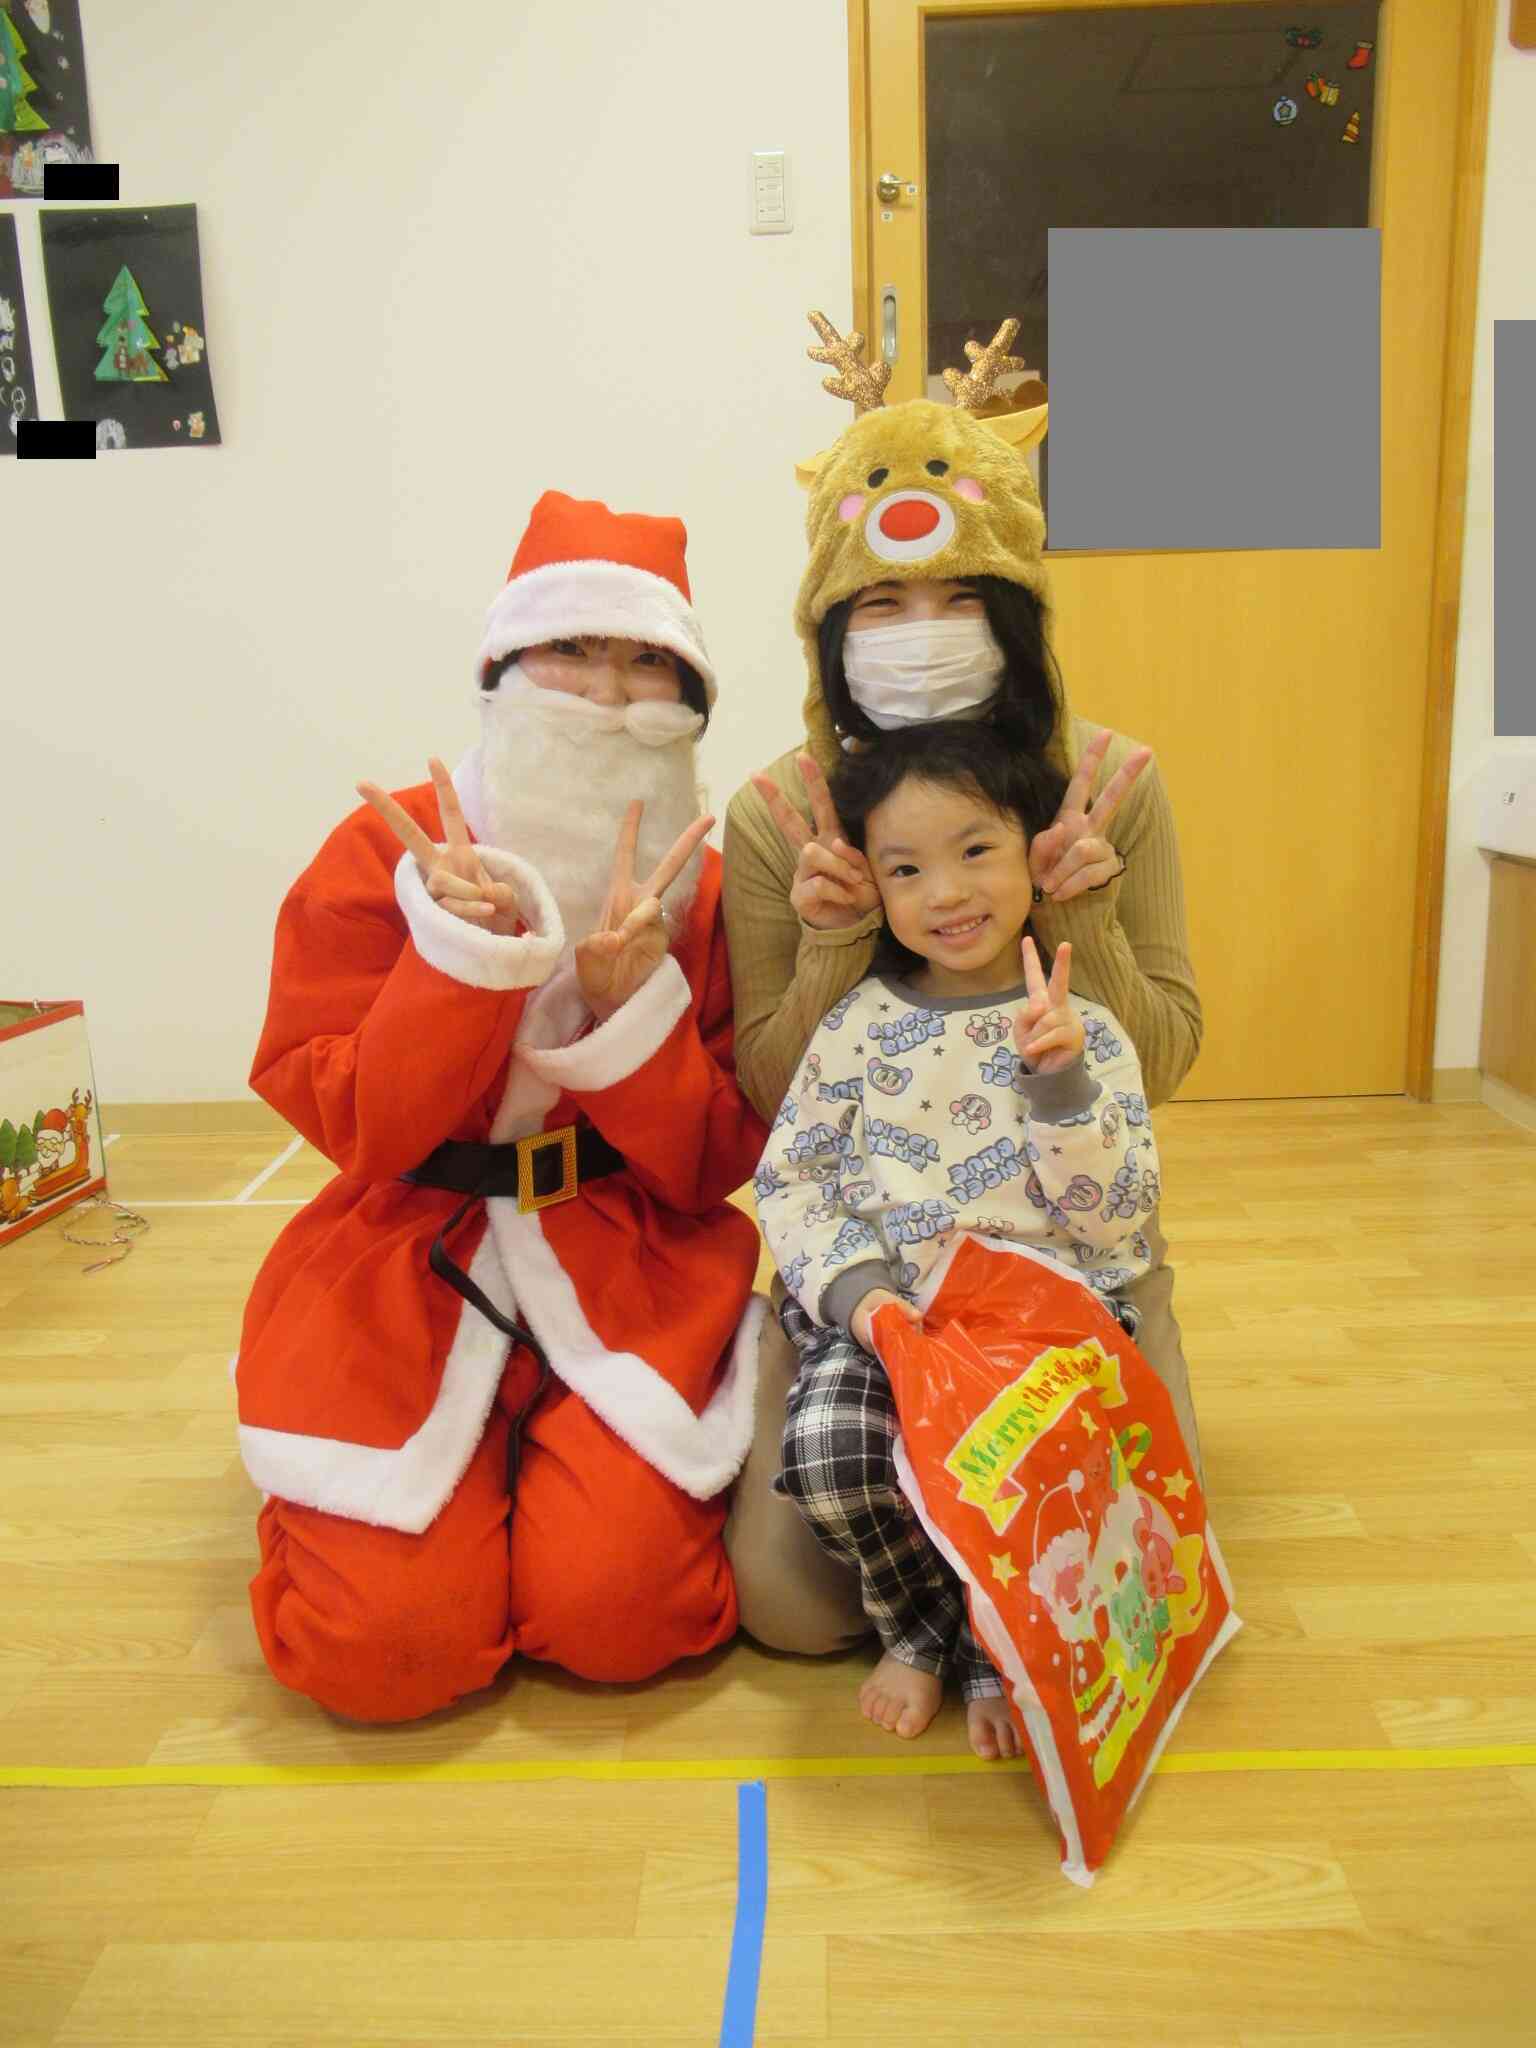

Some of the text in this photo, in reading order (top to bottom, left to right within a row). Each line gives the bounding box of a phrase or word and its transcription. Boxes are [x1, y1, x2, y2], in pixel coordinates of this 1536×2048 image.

[879, 1018, 946, 1057] BLUE
[947, 1136, 1016, 1185] BLUE
[959, 1407, 1038, 1487] Merry
